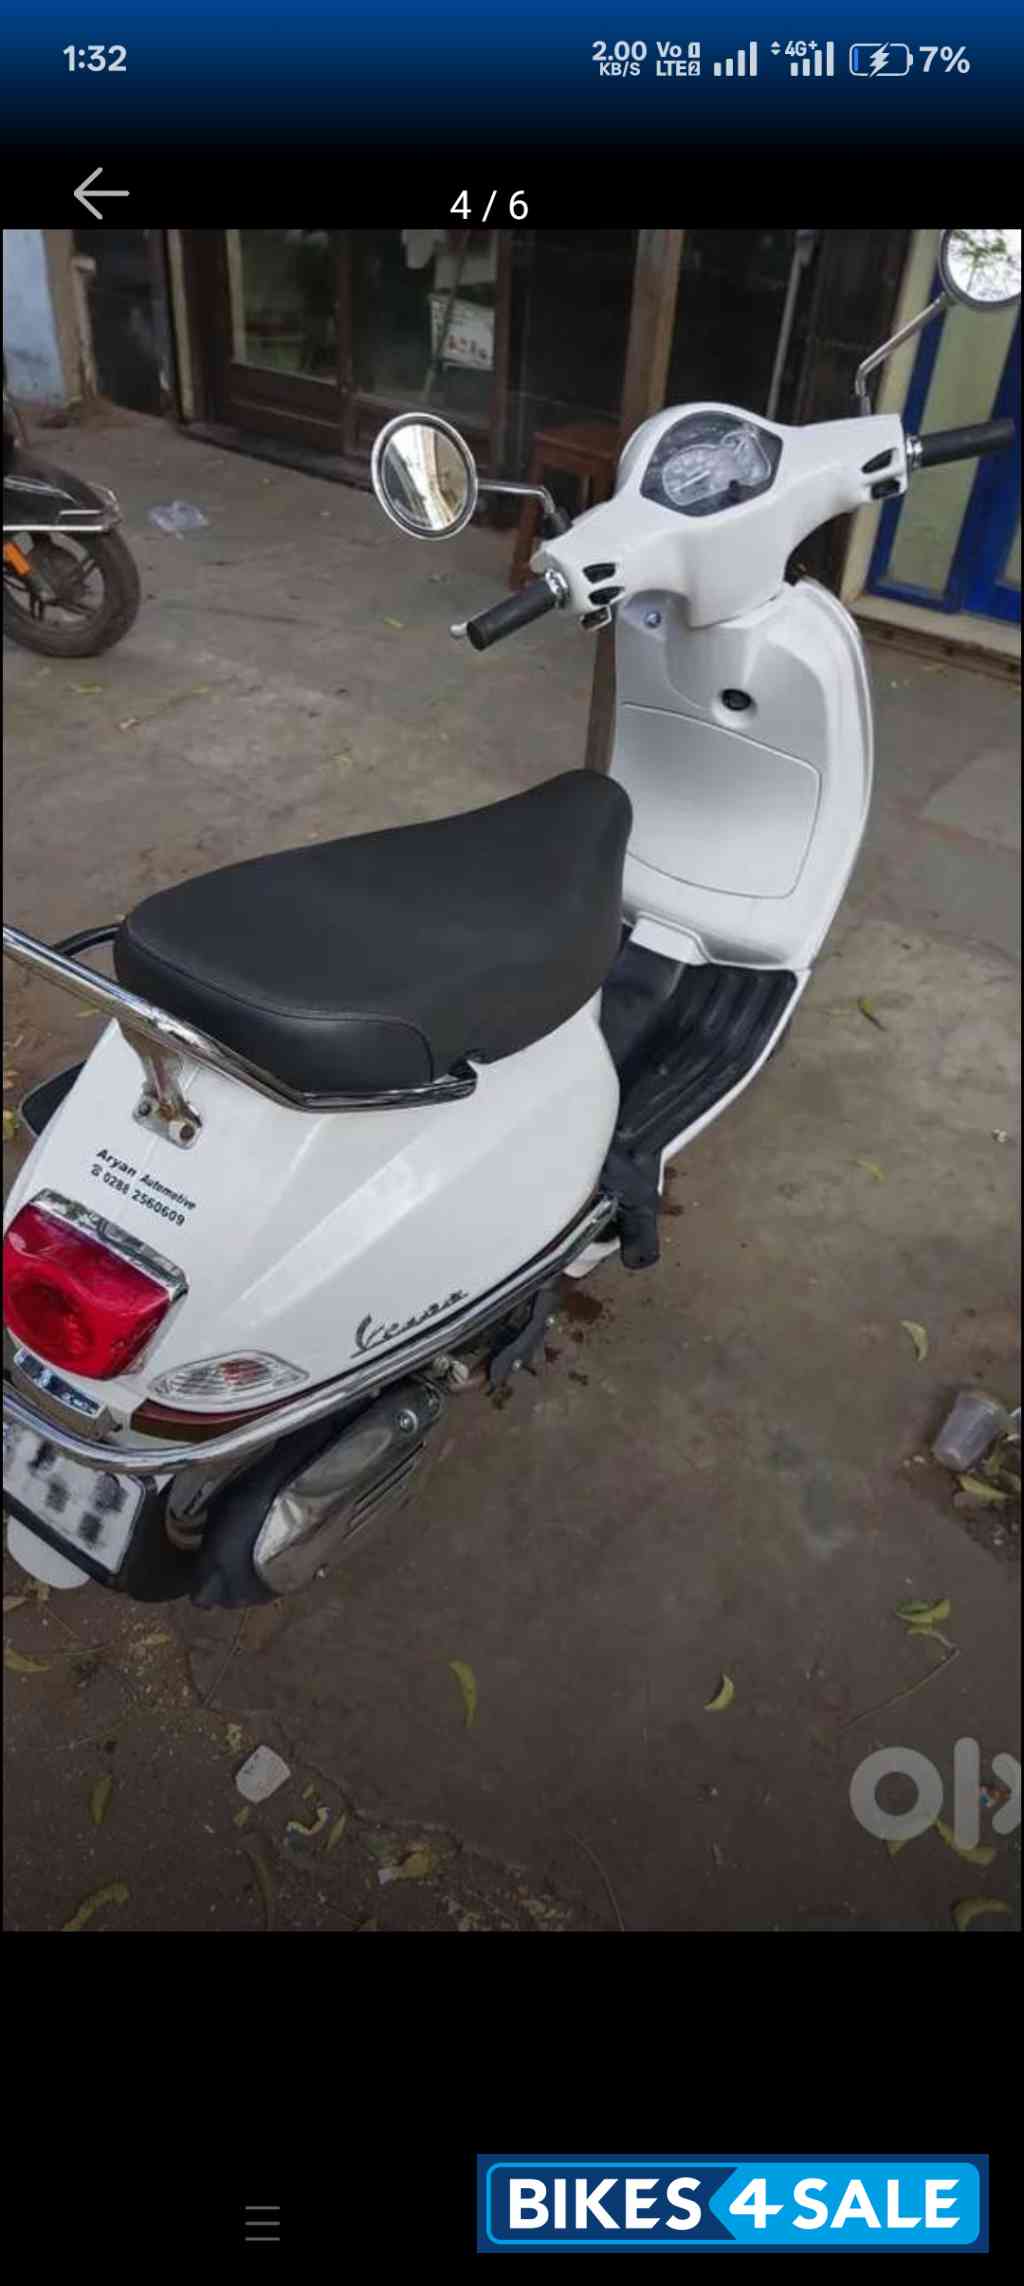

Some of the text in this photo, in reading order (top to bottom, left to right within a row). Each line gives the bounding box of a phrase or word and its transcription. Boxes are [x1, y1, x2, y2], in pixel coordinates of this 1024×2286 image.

[96, 1149, 196, 1210] Aryan Automotive
[132, 1189, 185, 1226] 2560609
